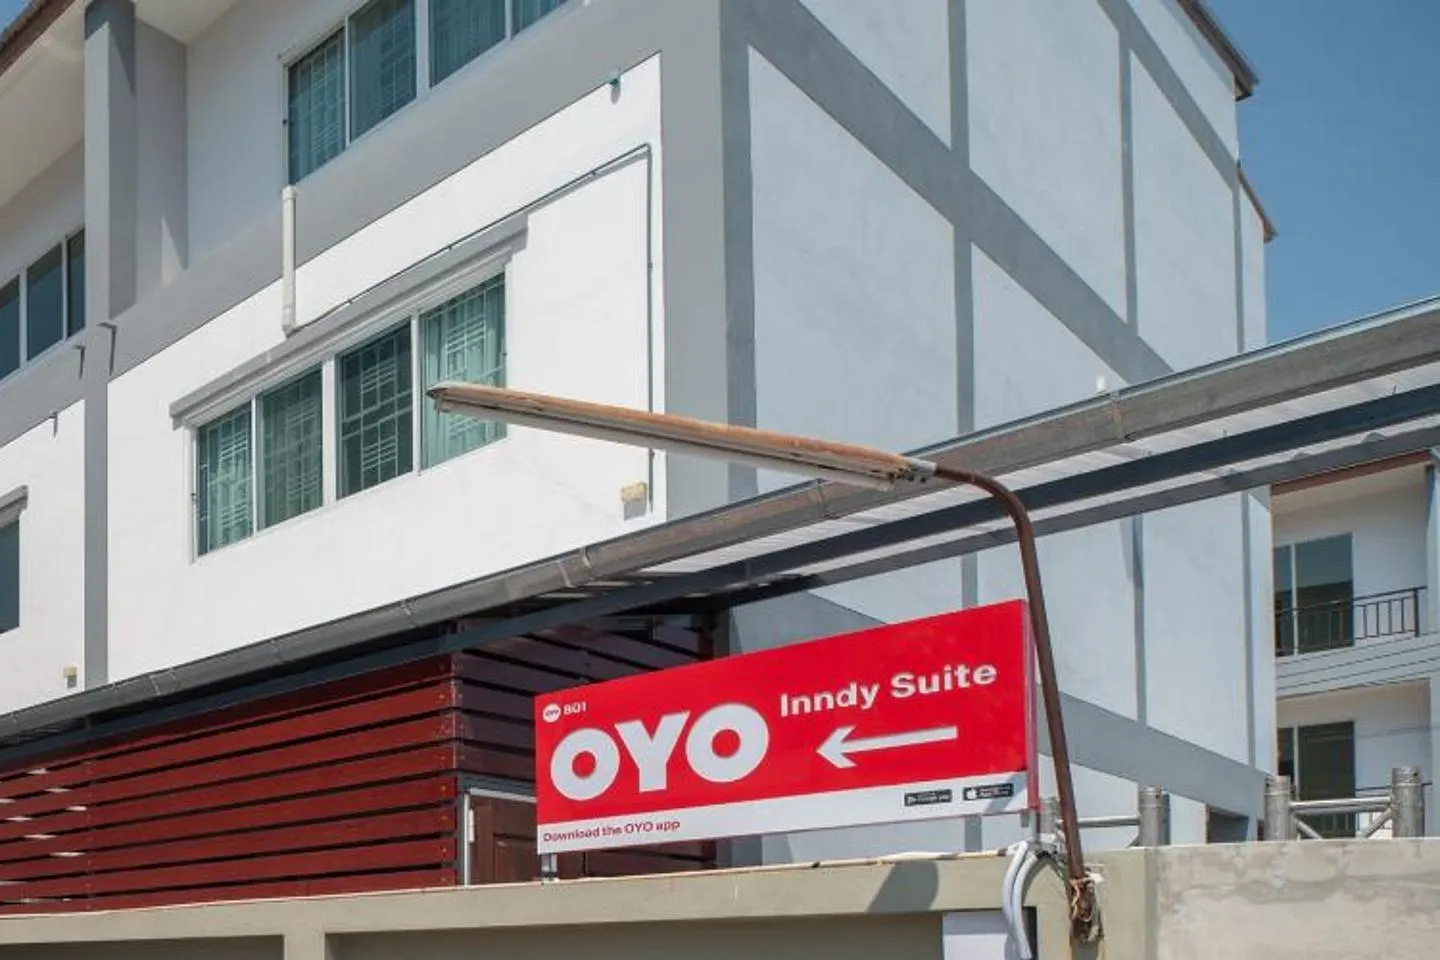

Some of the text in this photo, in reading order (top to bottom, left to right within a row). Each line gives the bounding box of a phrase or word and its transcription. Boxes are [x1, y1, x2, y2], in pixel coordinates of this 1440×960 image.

[563, 701, 587, 715] 801
[779, 663, 998, 717] Inndy Suite
[550, 703, 770, 801] OYO
[543, 820, 681, 842] Download the OYO app
